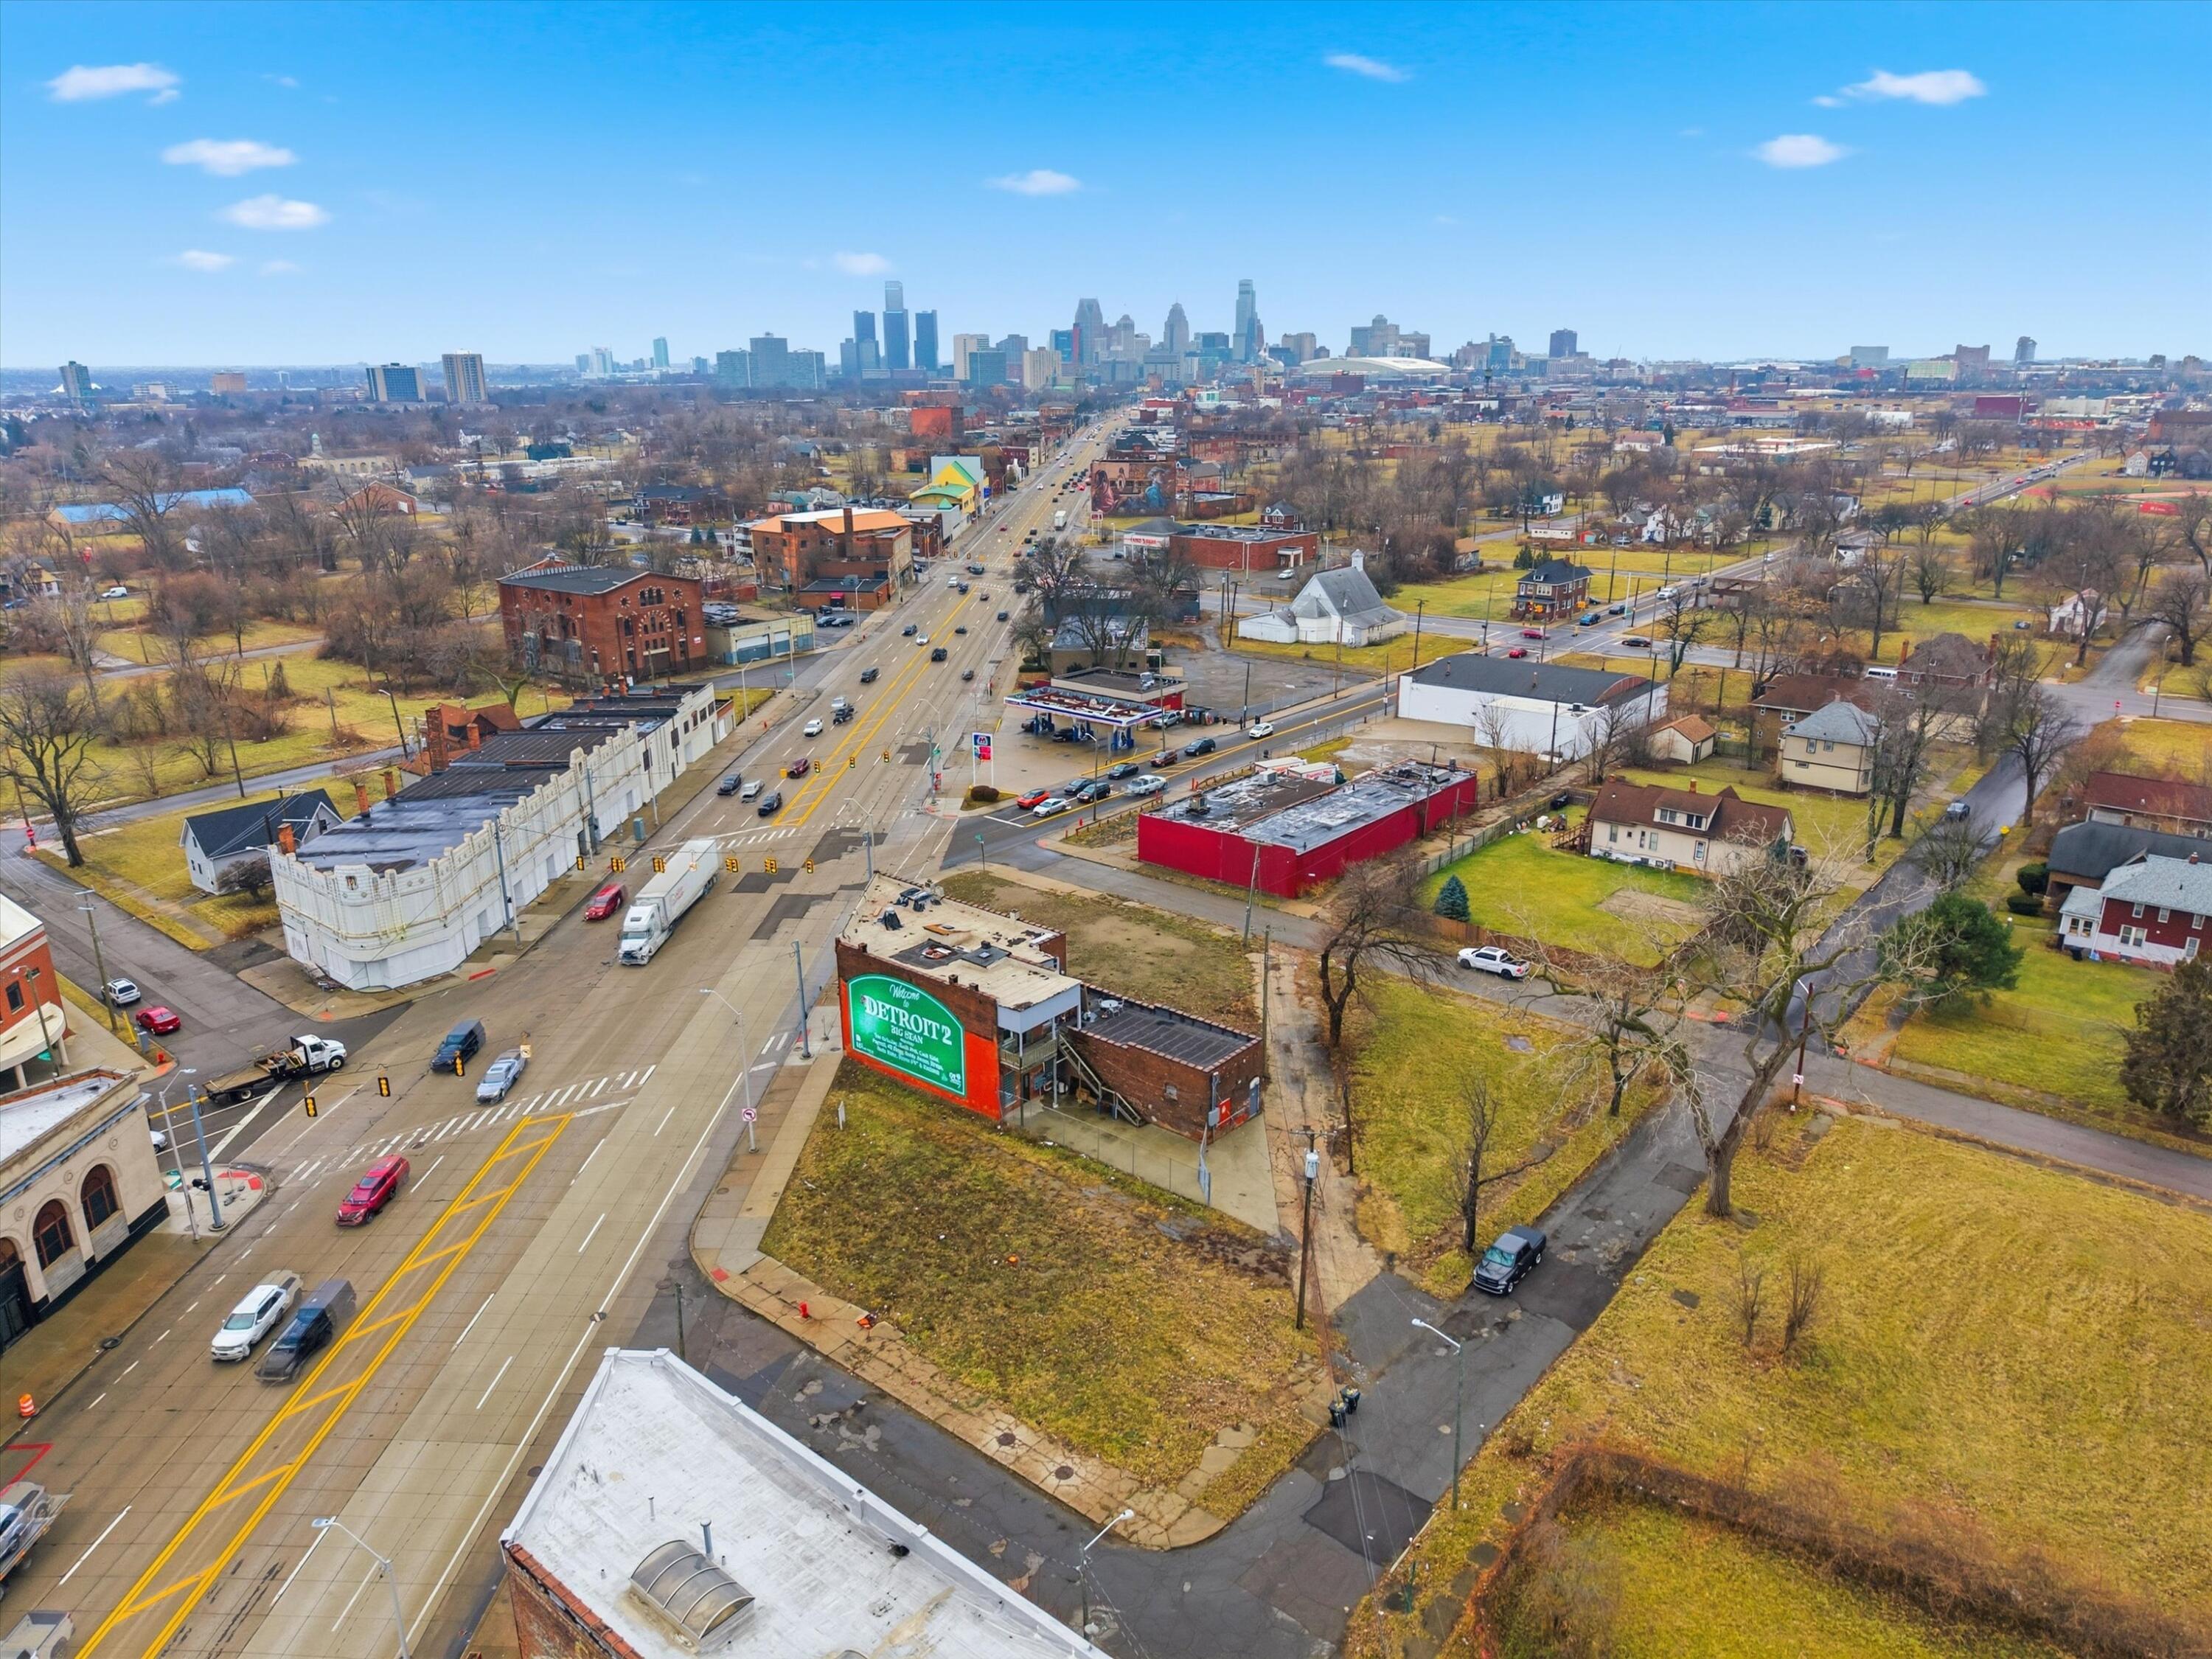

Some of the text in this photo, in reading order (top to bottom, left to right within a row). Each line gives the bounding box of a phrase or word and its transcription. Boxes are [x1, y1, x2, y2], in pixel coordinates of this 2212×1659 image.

[889, 984, 920, 1001] Welcome
[902, 999, 909, 1008] to
[863, 995, 953, 1046] DETROIT 2
